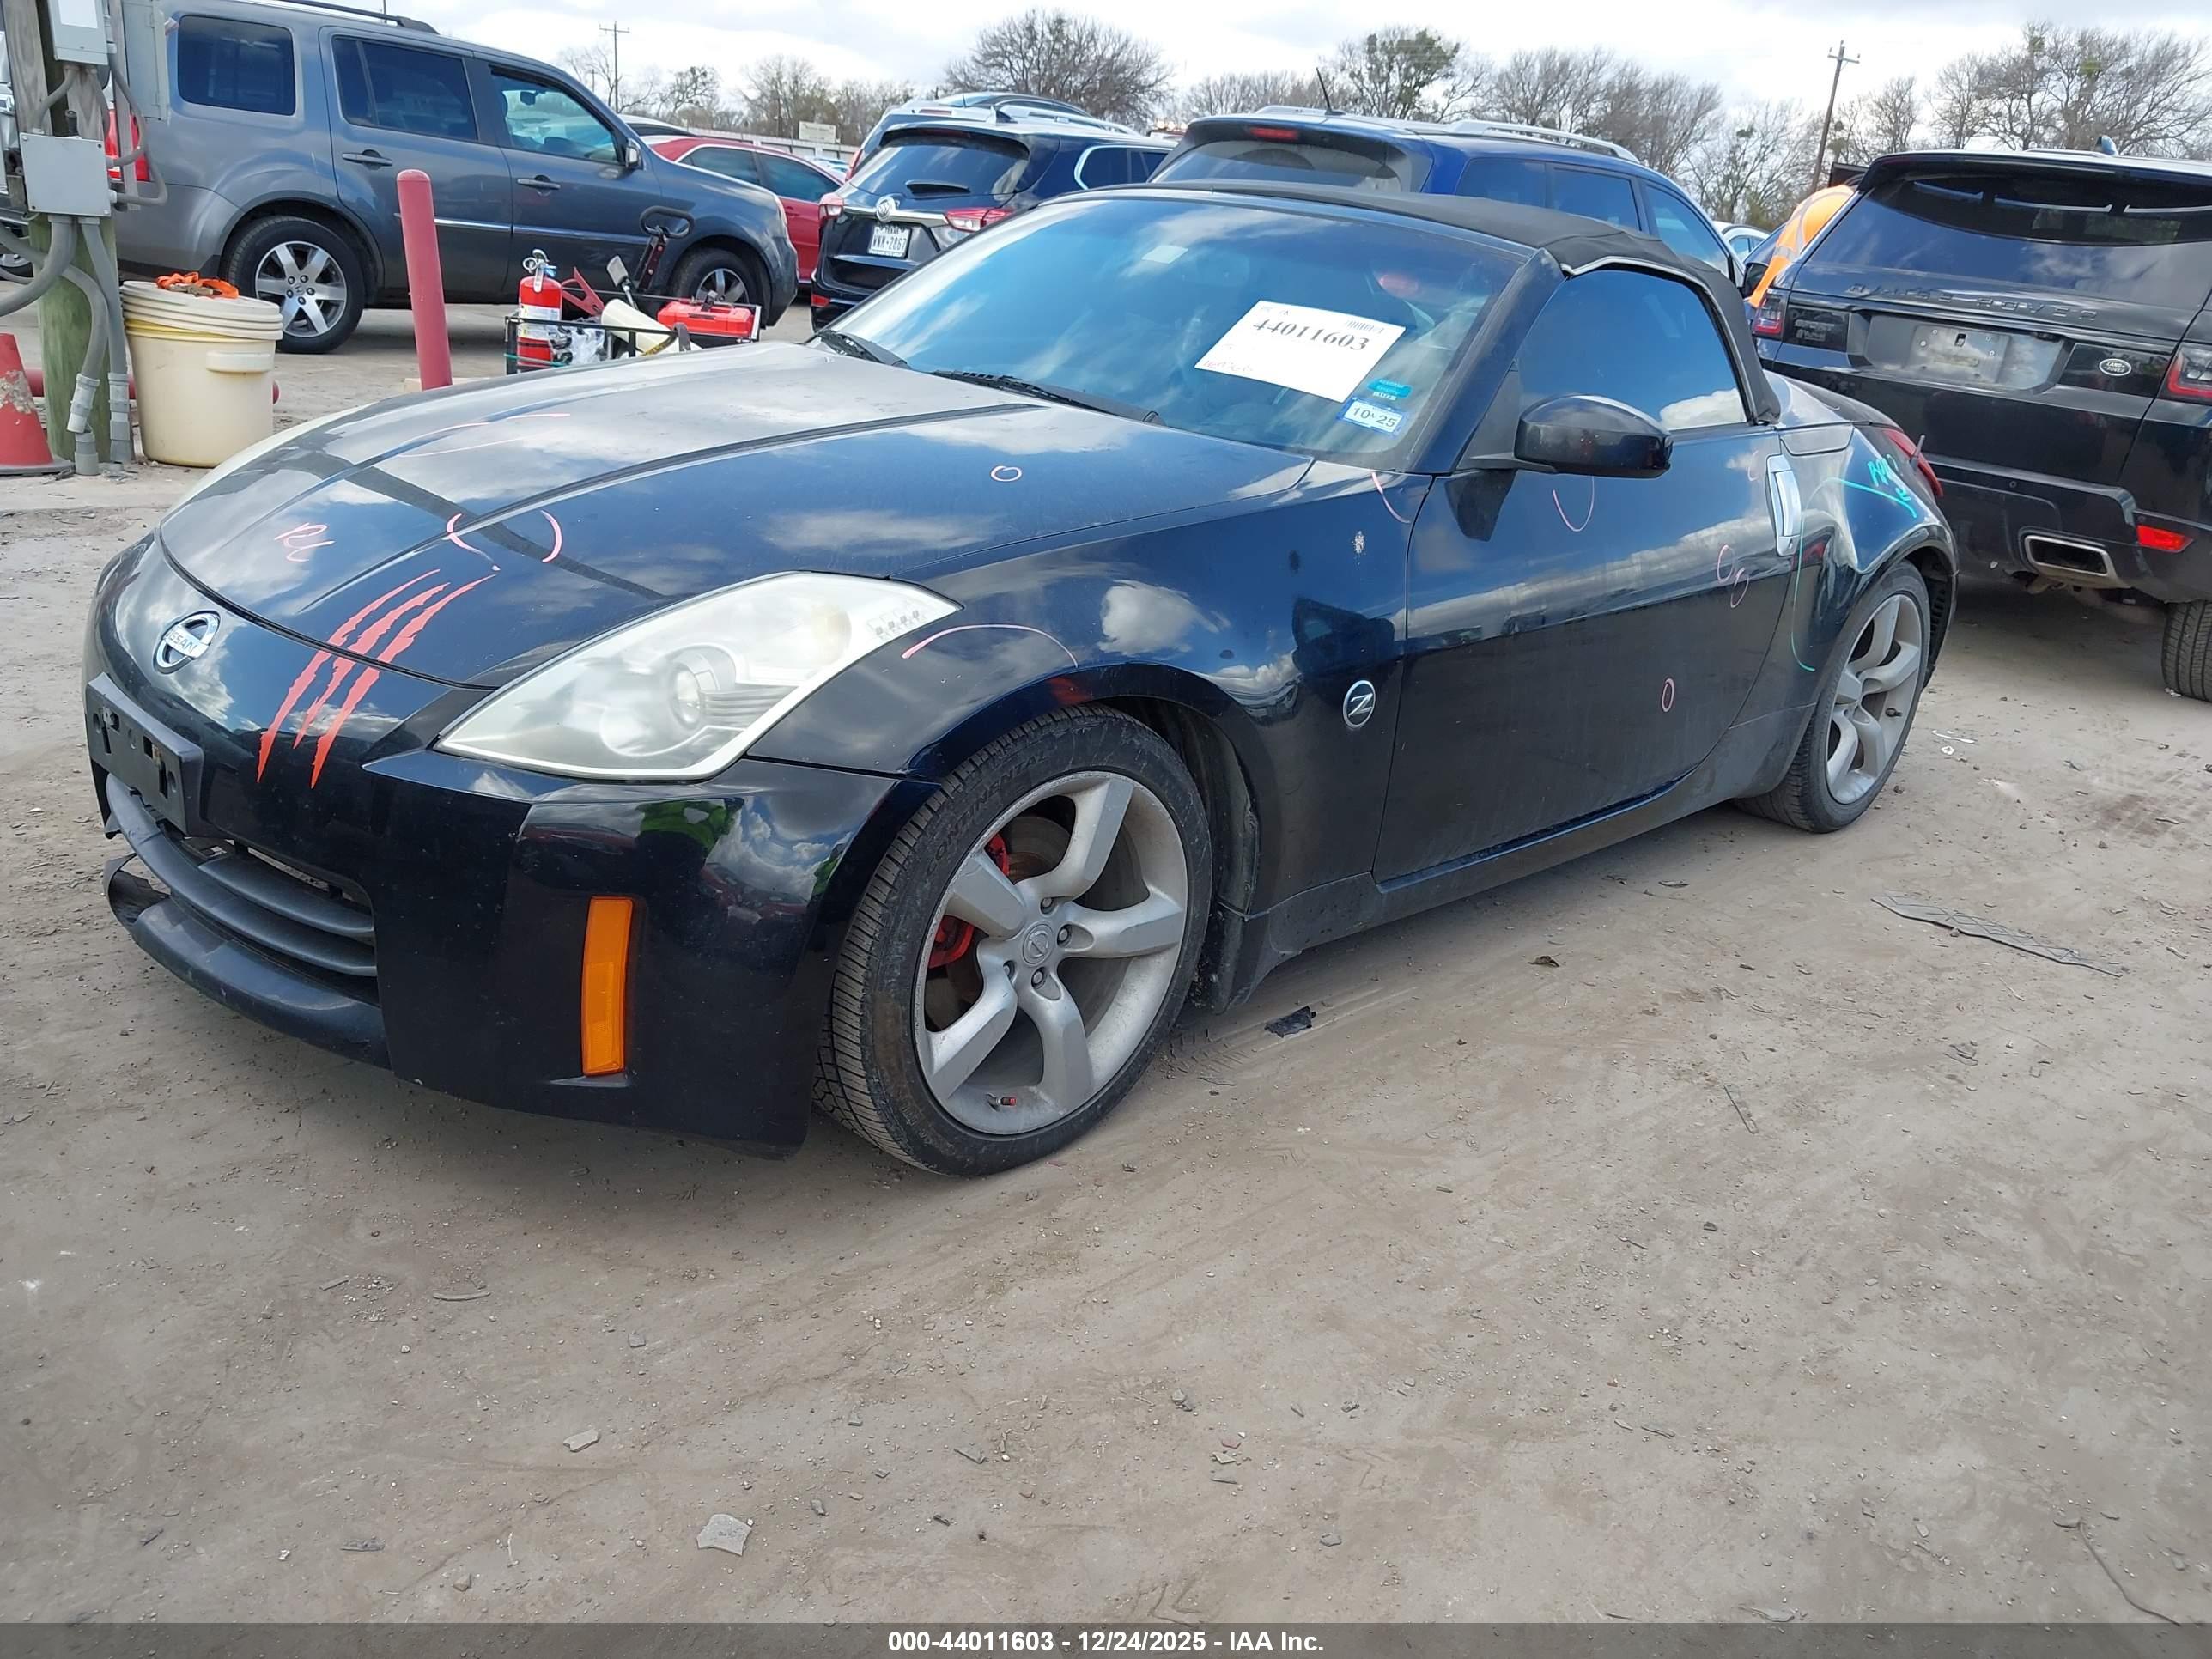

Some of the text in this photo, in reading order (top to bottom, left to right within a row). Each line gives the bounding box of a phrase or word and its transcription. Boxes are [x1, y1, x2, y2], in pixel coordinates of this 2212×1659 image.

[1975, 296, 2098, 322] ROVER
[1252, 319, 1370, 351] 44011603
[1376, 414, 1398, 428] 25
